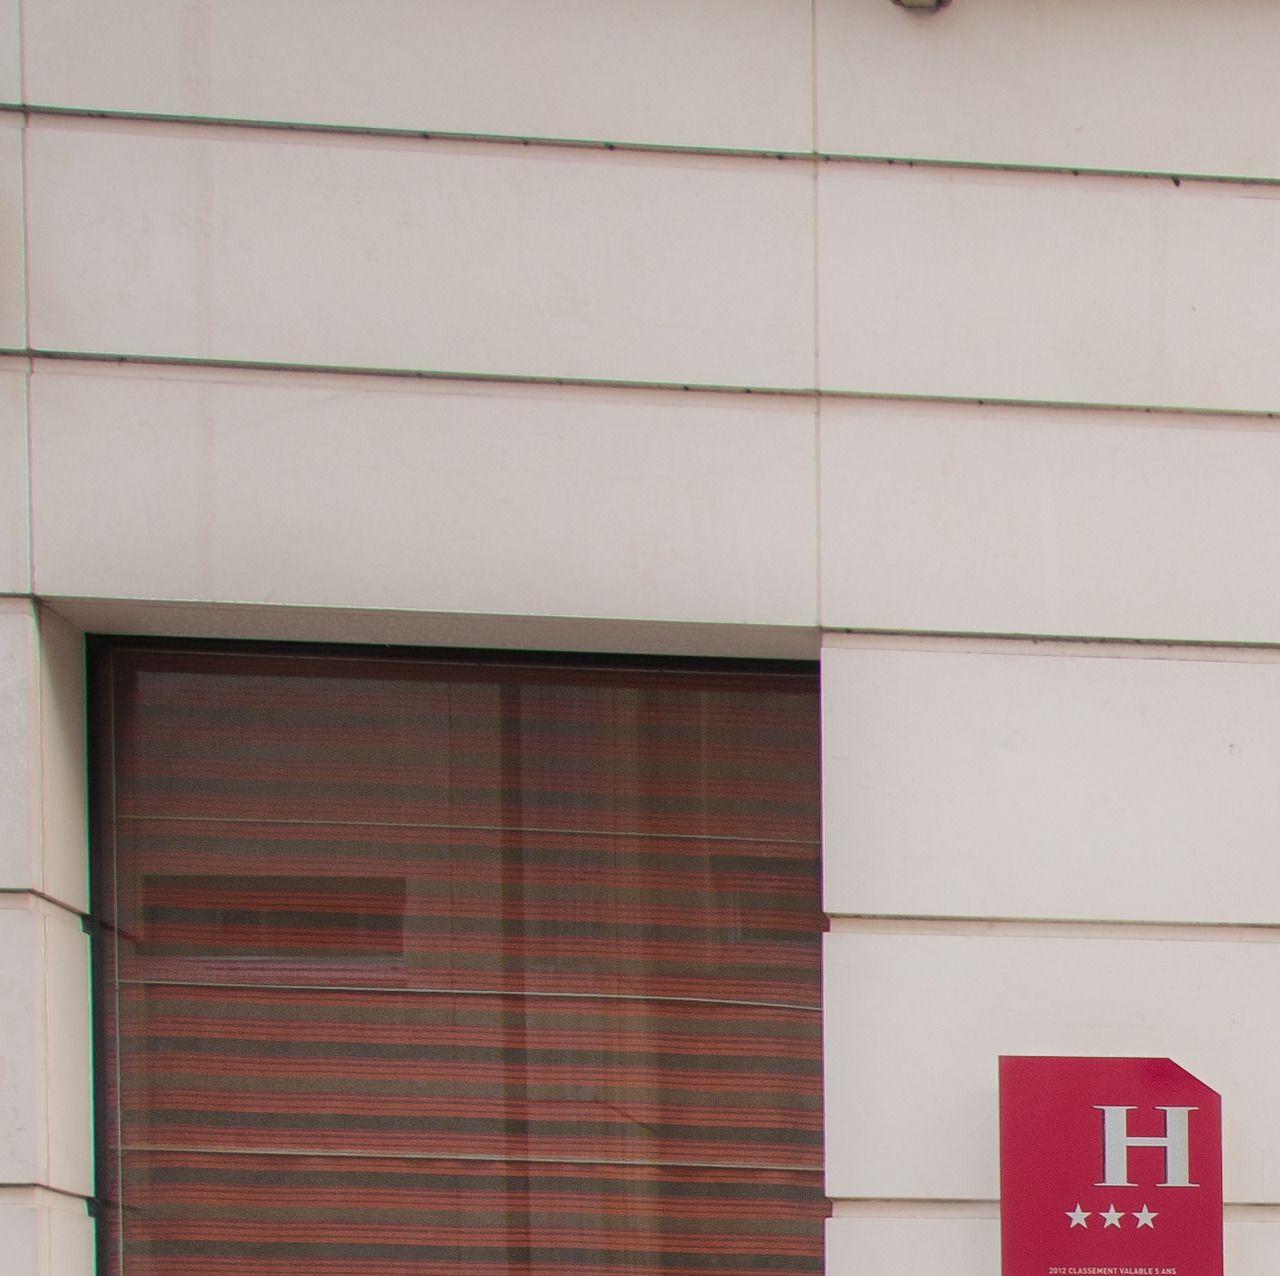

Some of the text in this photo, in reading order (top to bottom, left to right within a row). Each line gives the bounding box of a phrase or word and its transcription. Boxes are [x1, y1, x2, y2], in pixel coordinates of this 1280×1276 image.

[1091, 1105, 1200, 1187] H
[1049, 1267, 1066, 1275] 2012
[1068, 1267, 1118, 1275] CLASSEMENT
[1119, 1267, 1153, 1275] VALABLE
[1161, 1267, 1177, 1275] ANS
